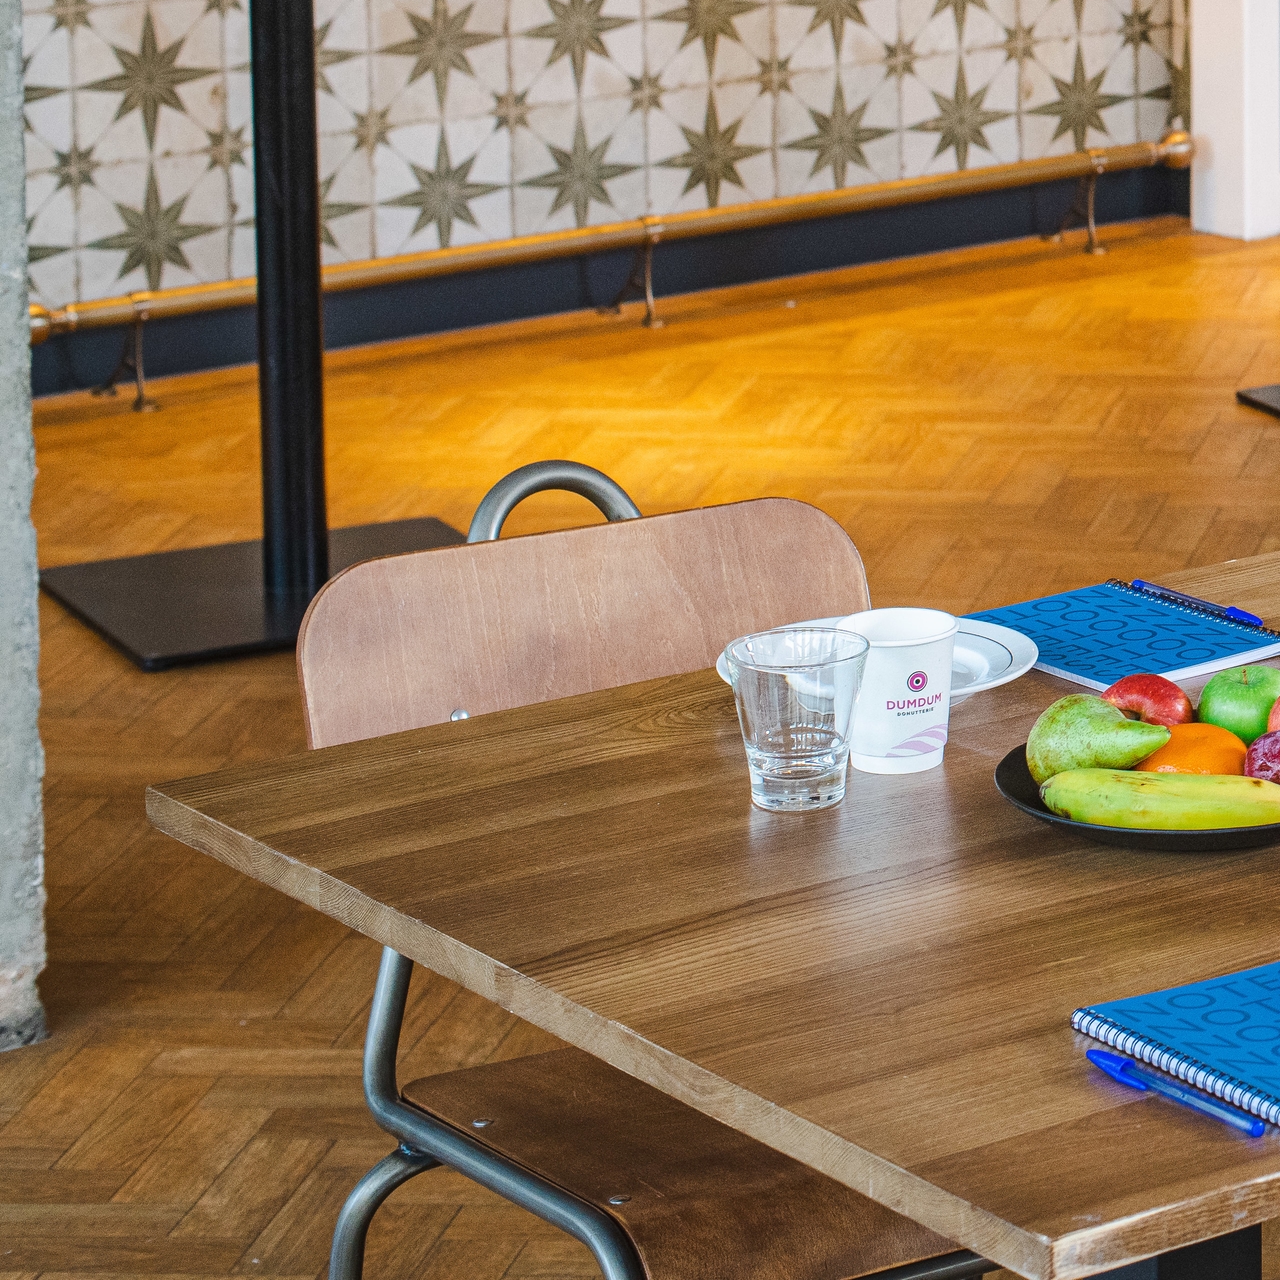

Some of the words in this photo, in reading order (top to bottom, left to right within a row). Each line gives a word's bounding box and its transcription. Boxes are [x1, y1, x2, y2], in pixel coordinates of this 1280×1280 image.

[970, 590, 1113, 624] NOTE
[1012, 599, 1142, 635] NOTE
[1035, 609, 1171, 647] NOTE
[1064, 627, 1230, 671] NOTES
[886, 692, 942, 710] DUMDUM
[897, 707, 935, 717] DONUTTERIE
